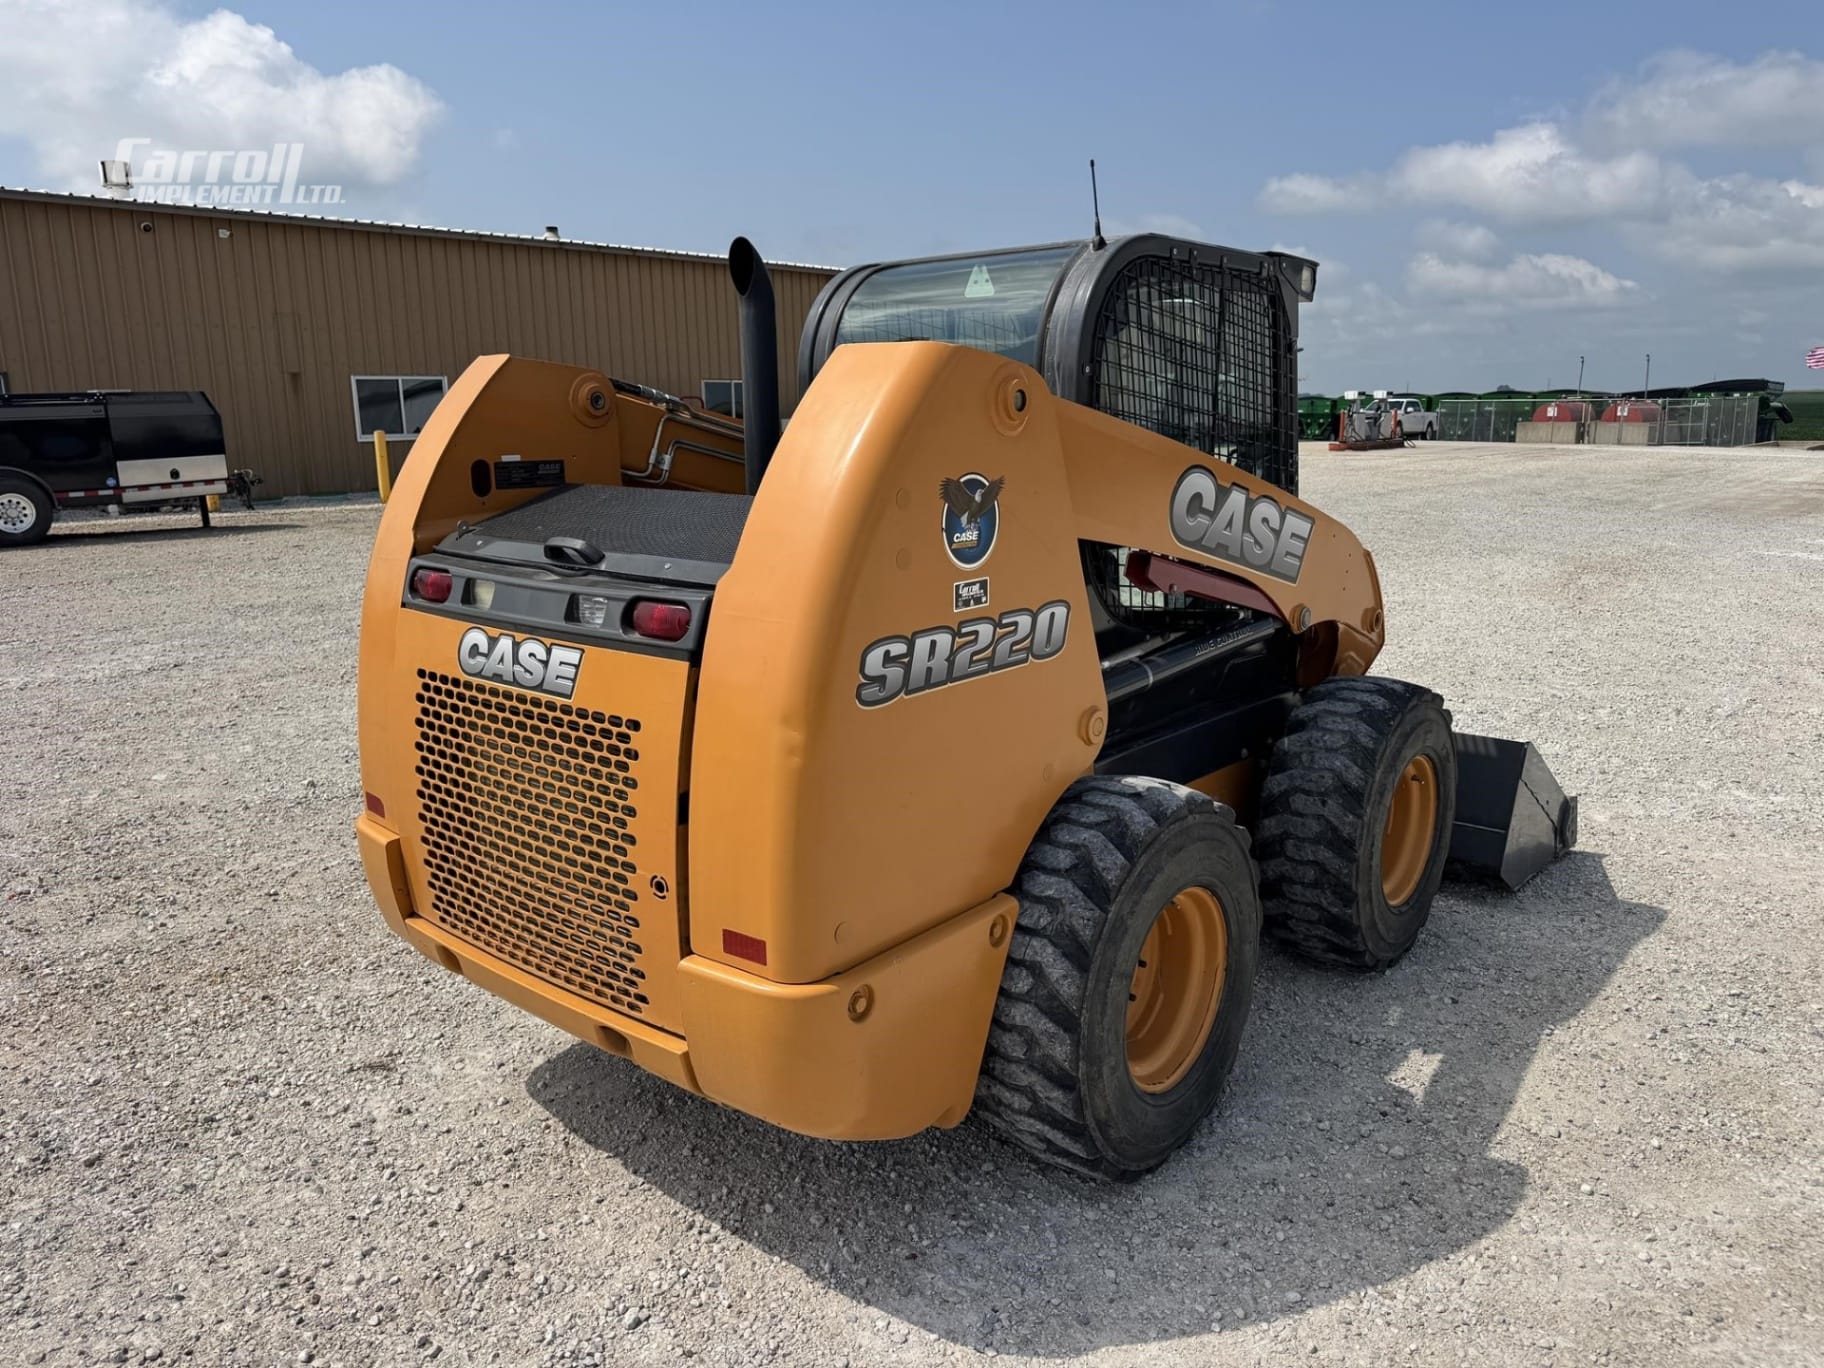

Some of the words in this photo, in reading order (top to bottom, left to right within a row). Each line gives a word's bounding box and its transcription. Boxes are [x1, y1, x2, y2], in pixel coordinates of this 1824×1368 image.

[953, 531, 979, 543] CASE
[1170, 465, 1314, 585] CASE
[459, 627, 585, 700] CASE
[856, 600, 1071, 708] SR220
